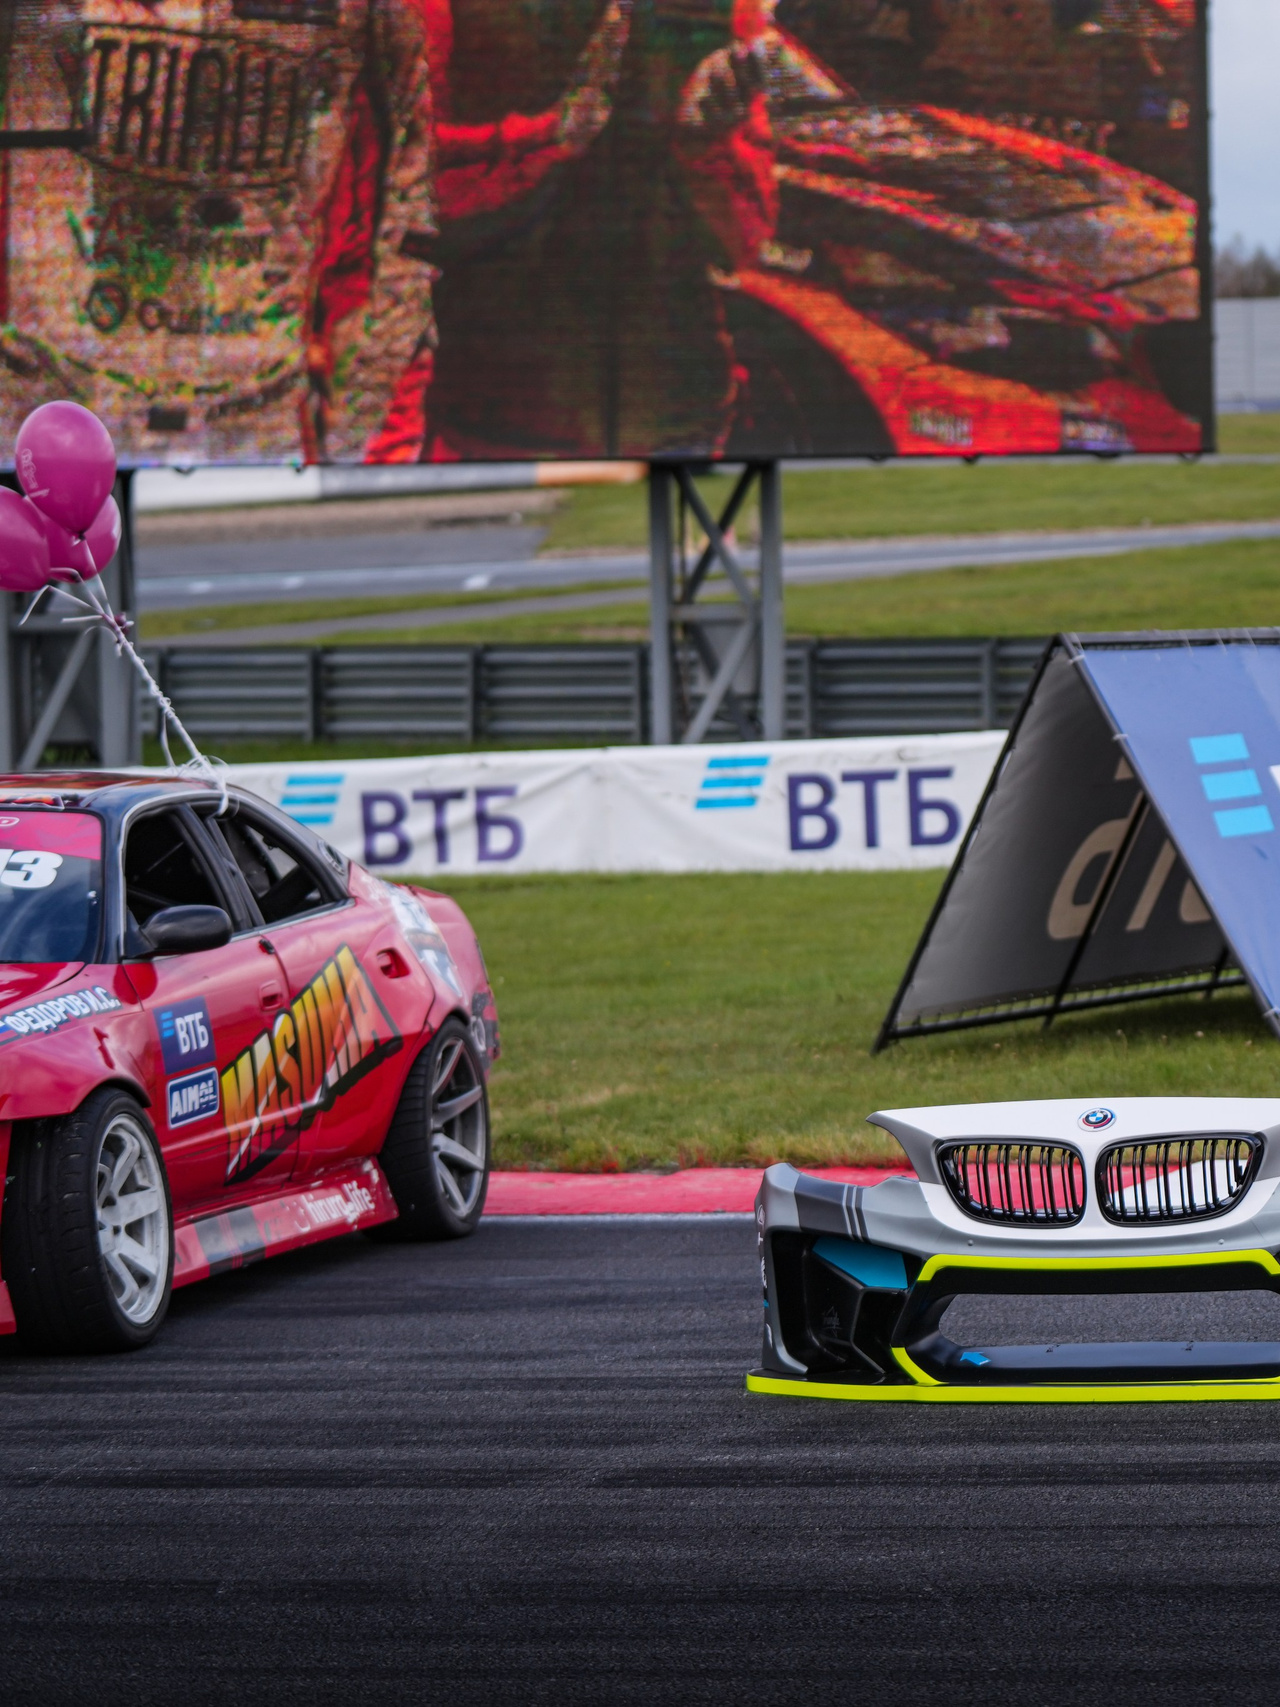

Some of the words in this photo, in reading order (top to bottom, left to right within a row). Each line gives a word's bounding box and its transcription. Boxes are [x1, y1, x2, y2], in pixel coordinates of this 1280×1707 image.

[361, 785, 524, 866] ВТБ
[787, 766, 962, 851] ВТБ
[4, 994, 92, 1034] ФЕДОРОВ
[175, 1011, 210, 1055] ВТБ
[220, 944, 402, 1184] MASUMA
[171, 1079, 218, 1119] AIMOL
